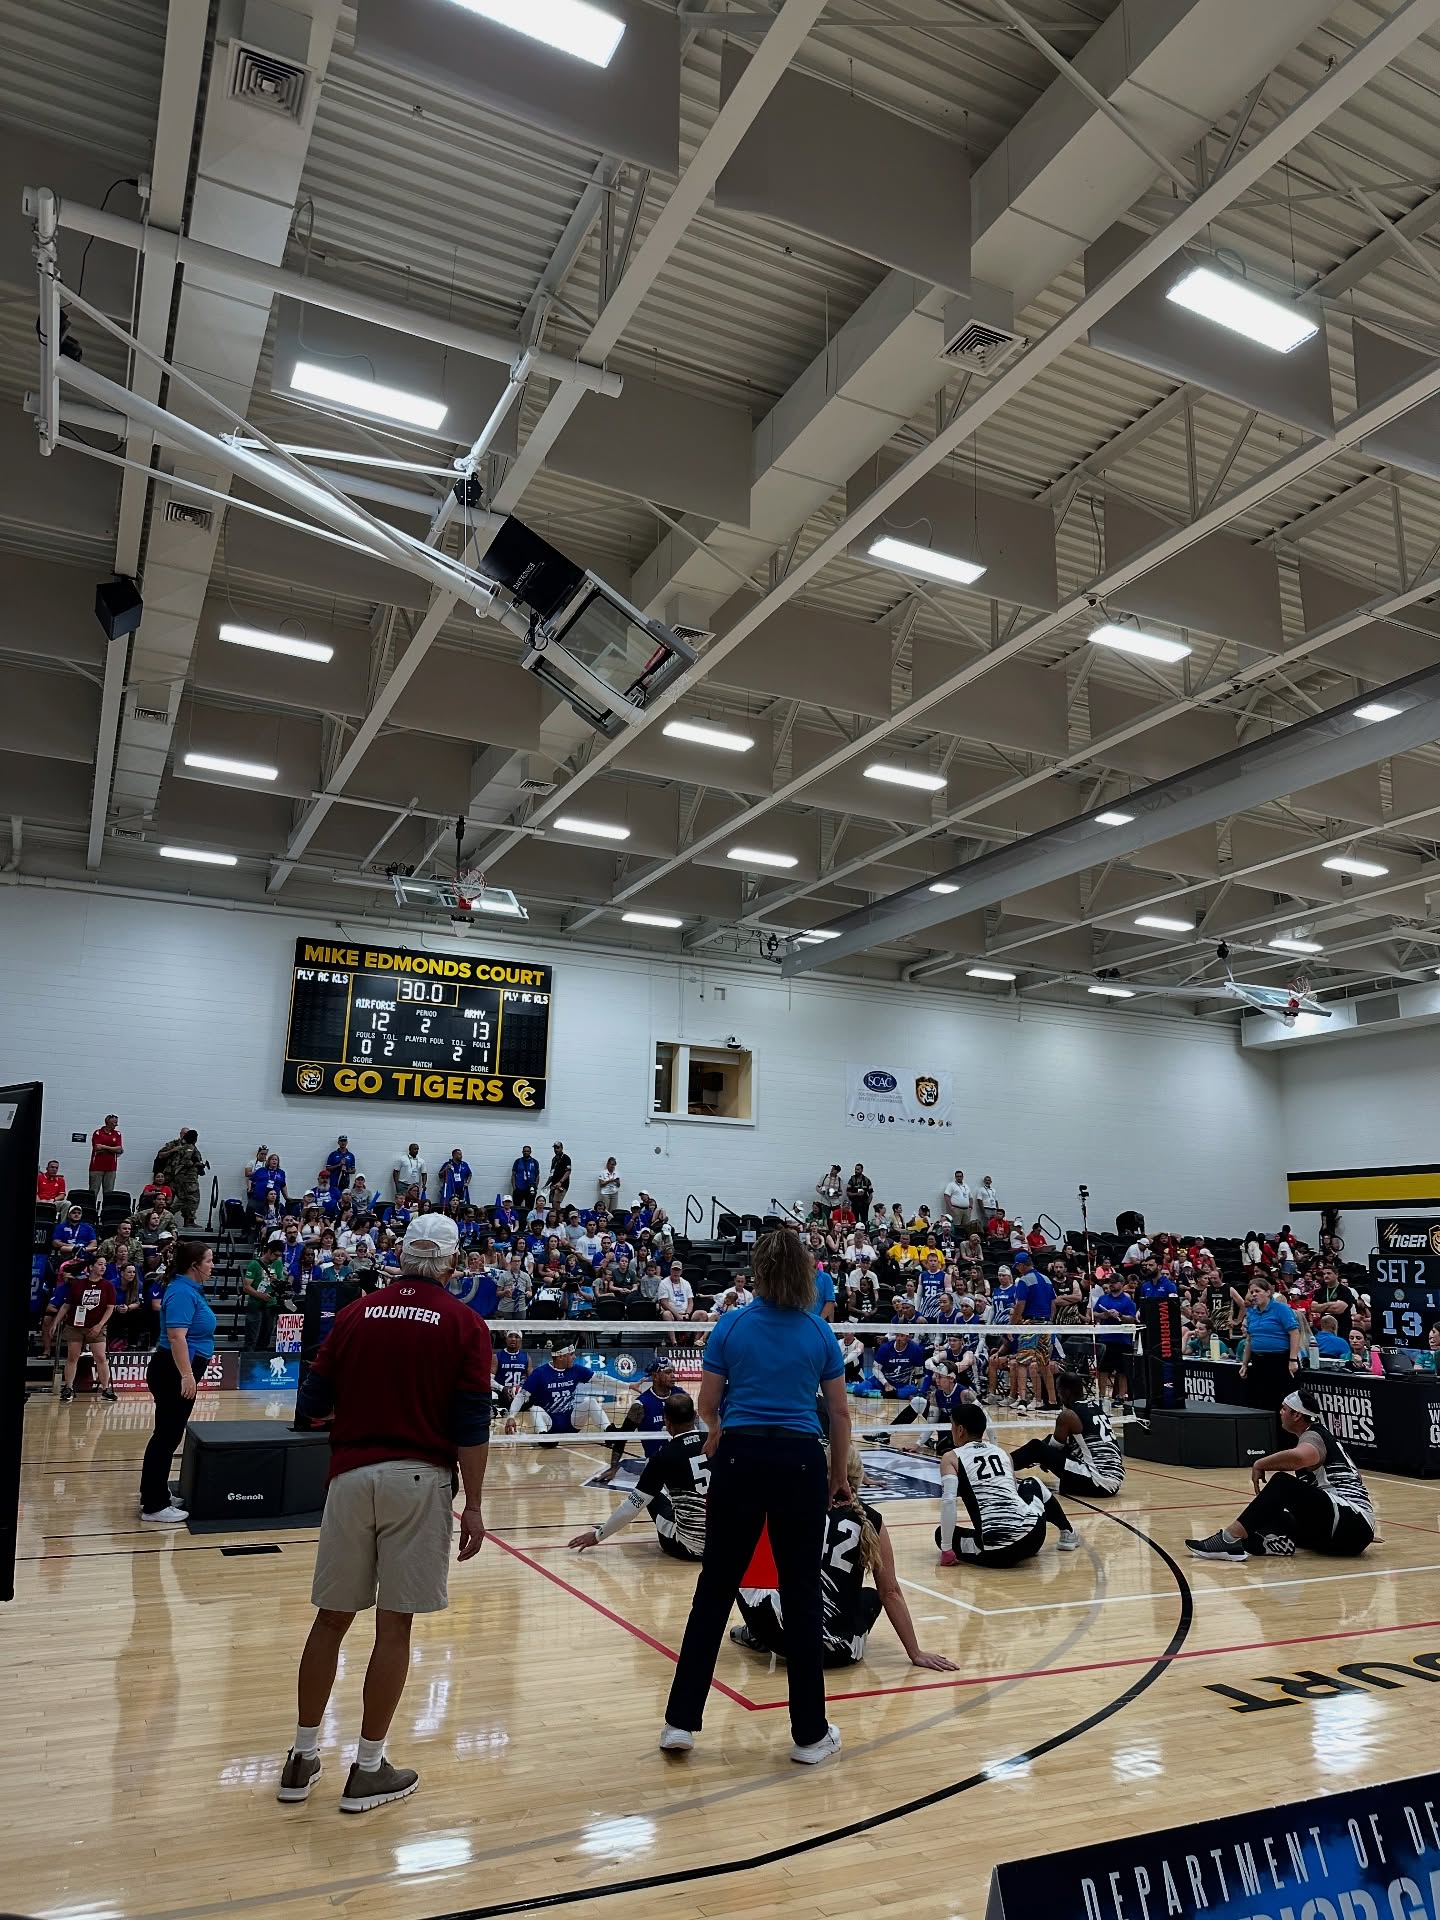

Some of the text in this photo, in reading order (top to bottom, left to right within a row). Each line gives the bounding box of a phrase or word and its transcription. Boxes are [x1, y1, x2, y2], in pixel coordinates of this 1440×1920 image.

[304, 945, 545, 986] MIKE EDMONDS COURT
[297, 969, 349, 984] PLY AC KLS
[401, 980, 443, 1003] 30.0
[504, 991, 549, 1005] PLY AC KLS
[416, 1009, 438, 1018] PERIOD
[464, 1008, 486, 1020] ARMY
[371, 1011, 390, 1032] 12
[420, 1018, 431, 1034] 2
[355, 1031, 376, 1039] FOULS
[473, 1021, 490, 1040] 13
[404, 1035, 427, 1043] PLAYER
[472, 1041, 491, 1049] FOULS
[361, 1039, 372, 1055] 0
[383, 1040, 395, 1056] 2
[452, 1046, 463, 1062] 2
[352, 1055, 373, 1064] SCORE
[483, 1049, 488, 1063] 1
[412, 1060, 433, 1069] MATCH
[470, 1064, 489, 1073] SCORE
[333, 1068, 504, 1102] GO TIGERS
[867, 1076, 893, 1088] SCAC
[1388, 1234, 1428, 1248] TIGER
[1376, 1259, 1426, 1284] SET 2
[1212, 1299, 1222, 1310] 13
[1426, 1293, 1435, 1308] 1
[364, 1305, 441, 1326] VOLUNTEER
[1158, 1301, 1172, 1358] WARRIOR
[1382, 1310, 1423, 1337] 13
[504, 1371, 522, 1386] 20
[973, 1454, 1006, 1480] 20
[235, 1493, 264, 1501] Senoh
[1080, 1826, 1329, 1920] DEPARTMENT
[1347, 1813, 1387, 1870] OF
